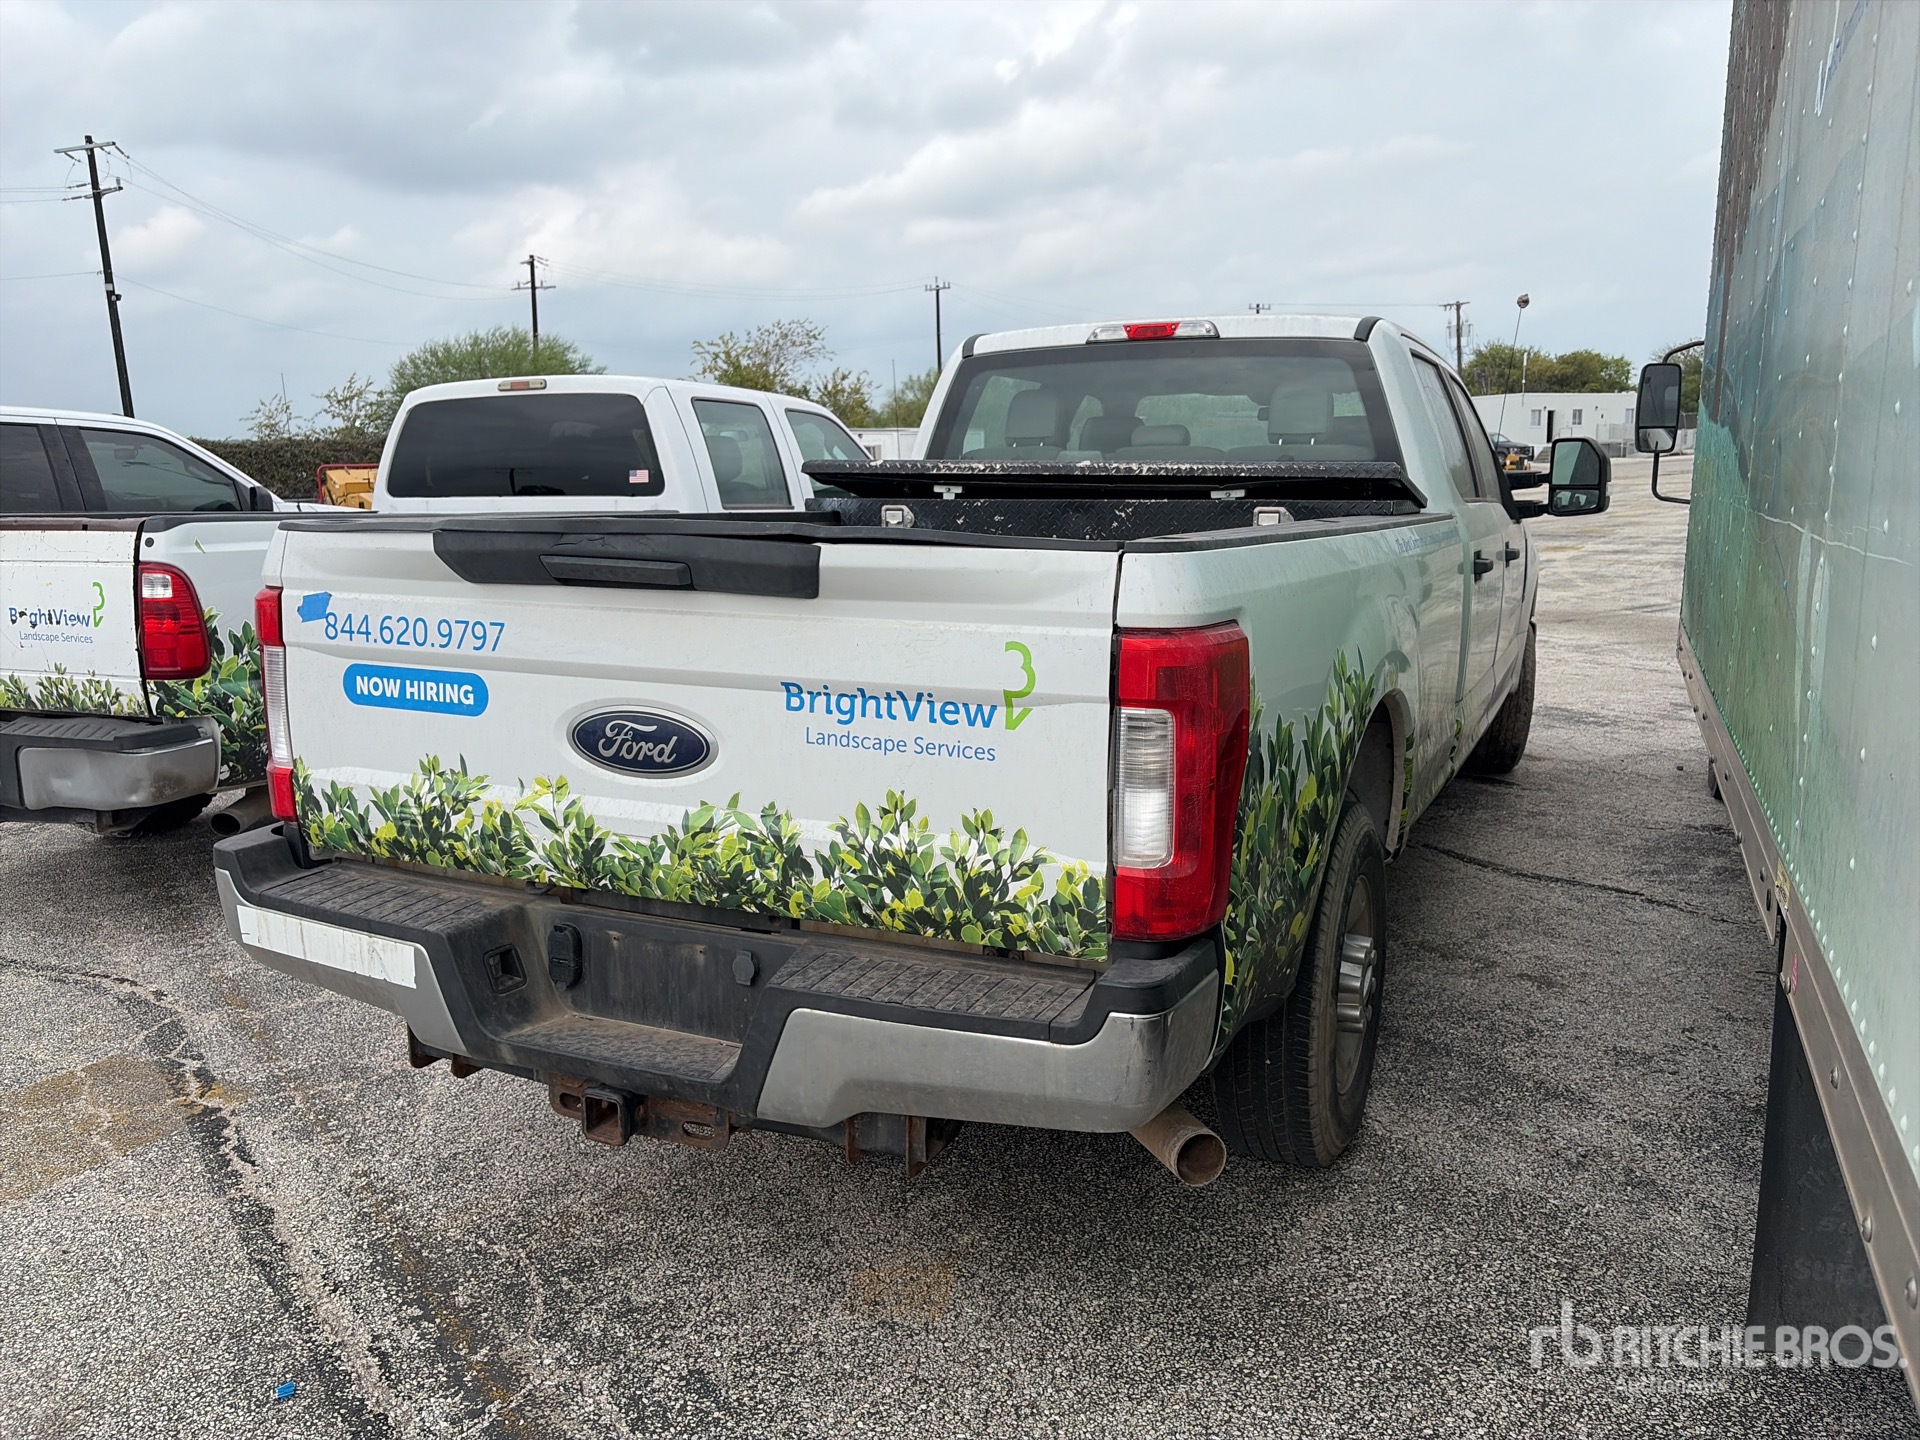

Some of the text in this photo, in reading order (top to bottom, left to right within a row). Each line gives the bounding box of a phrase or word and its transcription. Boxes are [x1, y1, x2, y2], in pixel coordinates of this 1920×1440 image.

[8, 607, 91, 629] BghtView
[324, 611, 506, 652] 844.620.9797
[19, 630, 94, 644] Landscape Services
[355, 675, 474, 706] NOW HIRING
[780, 681, 998, 729] BrightView
[597, 720, 679, 764] Ford
[805, 727, 996, 762] Landscape Services
